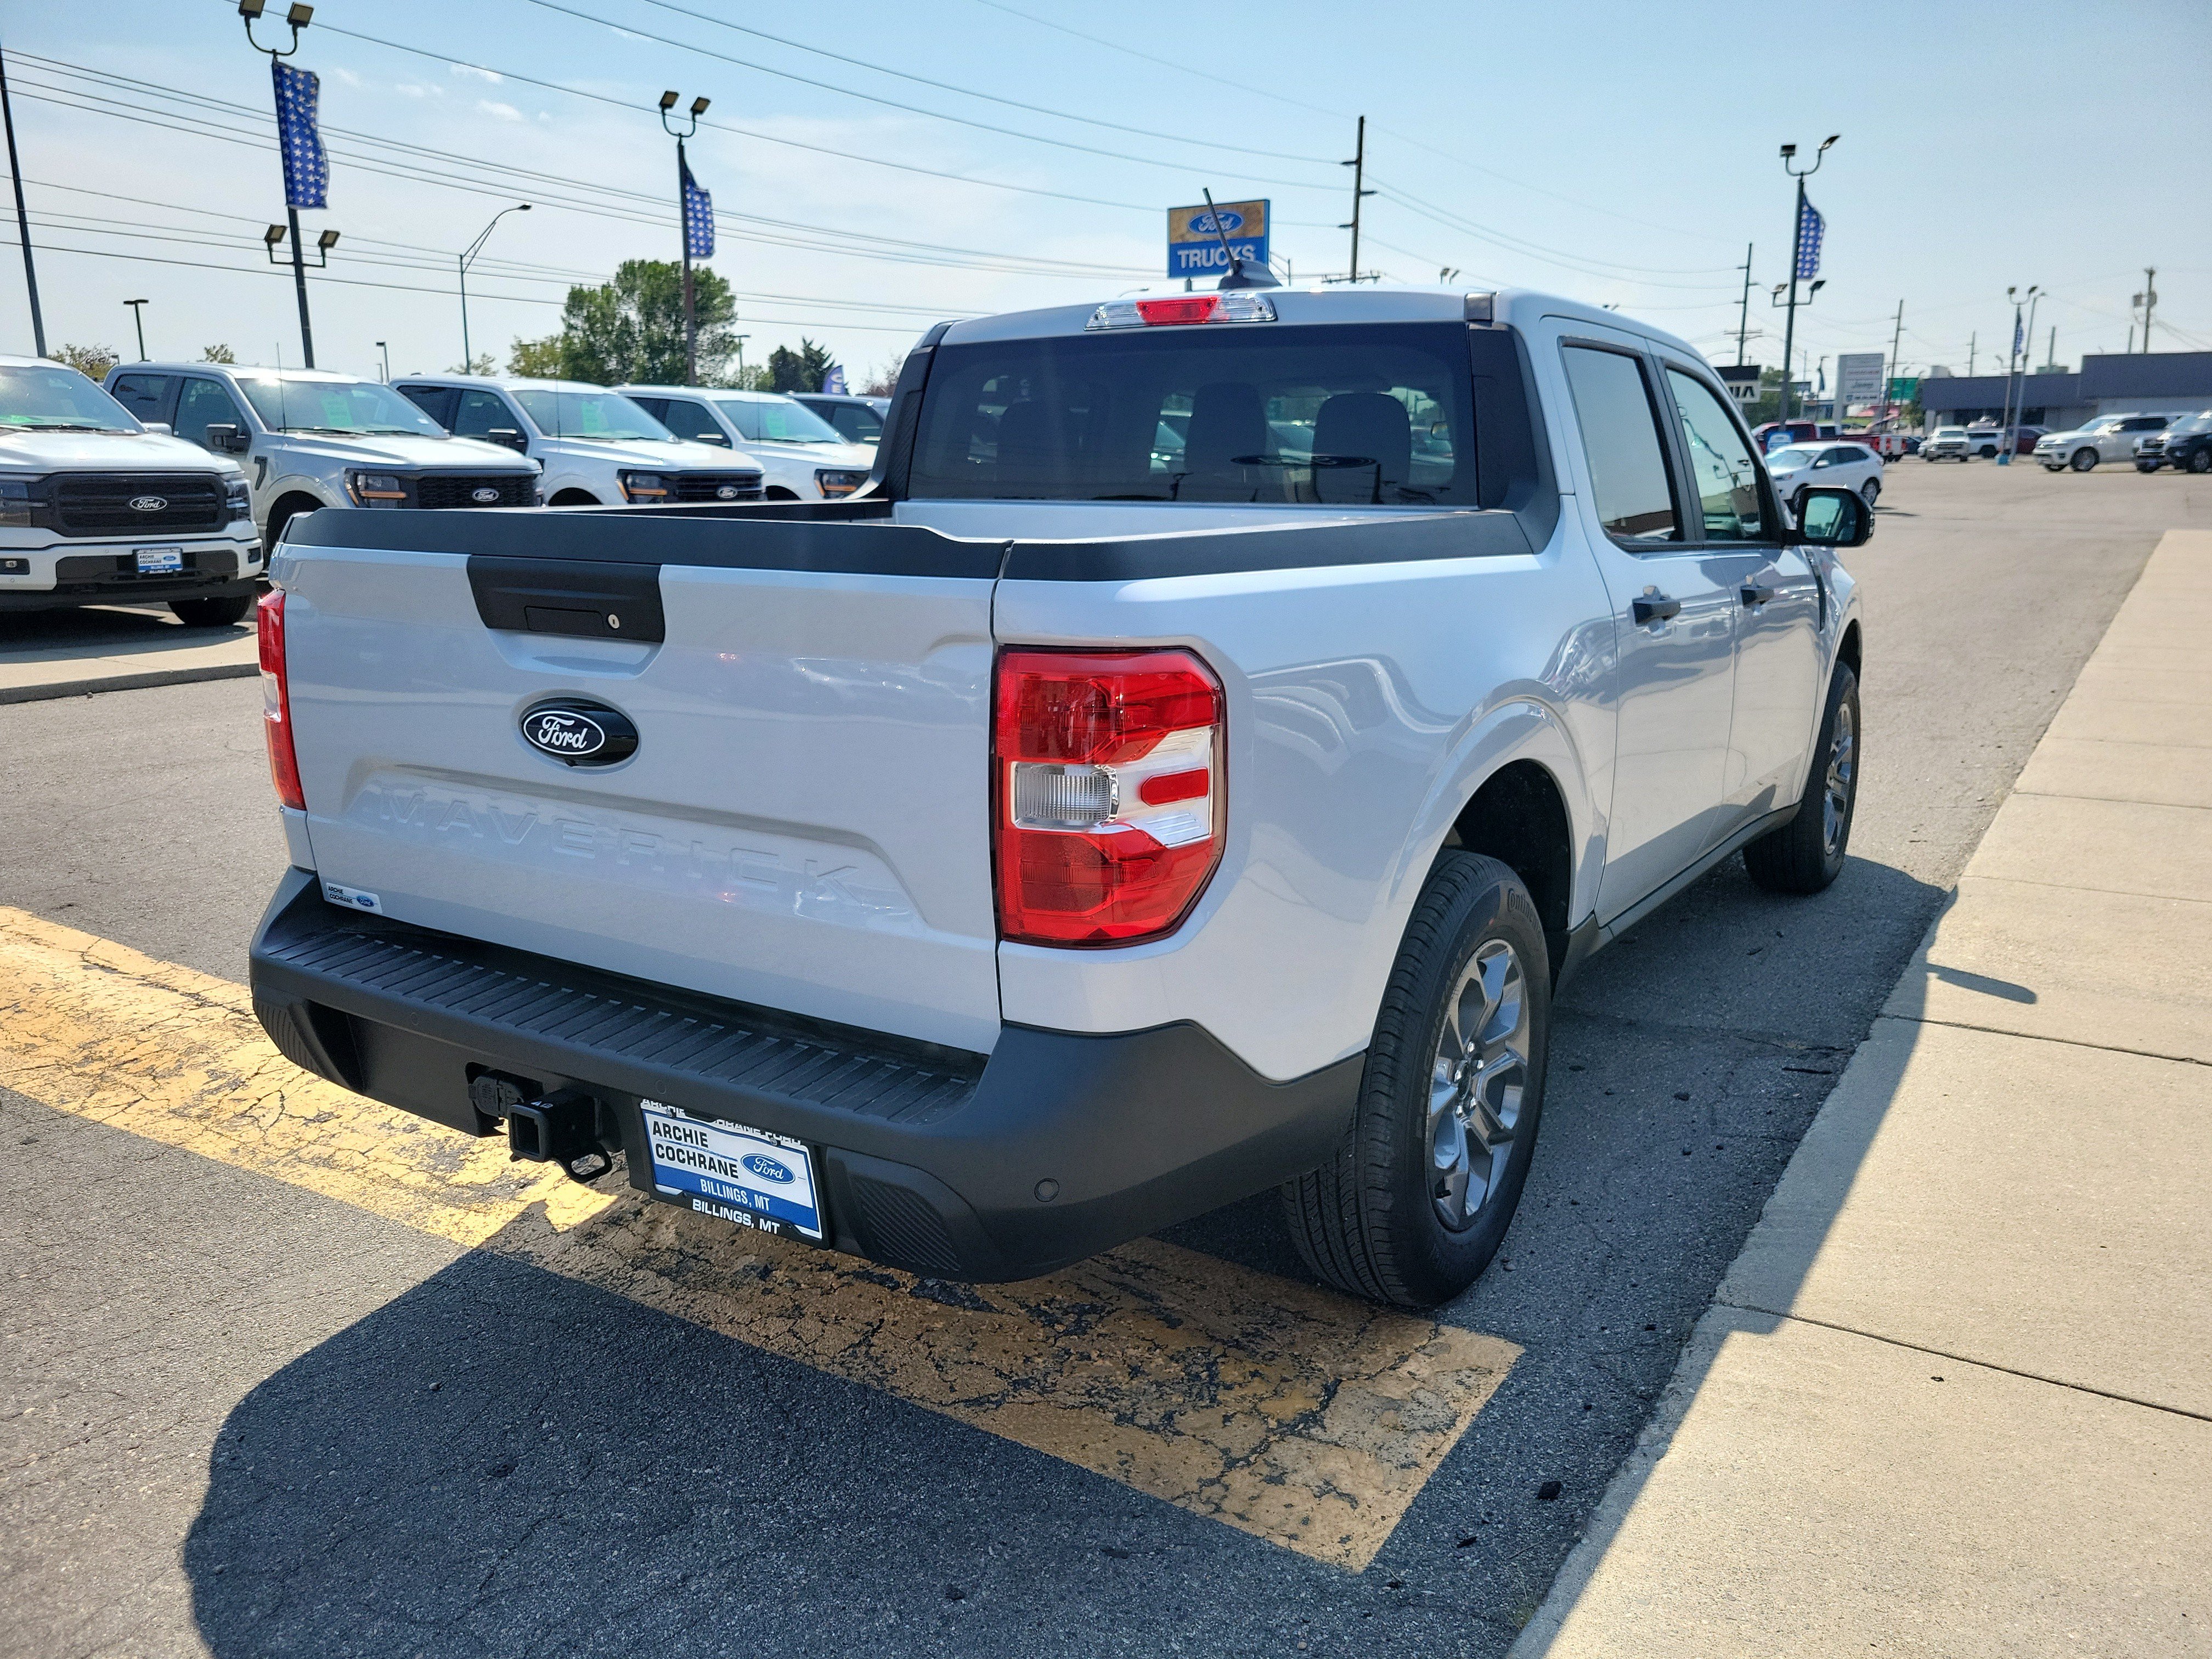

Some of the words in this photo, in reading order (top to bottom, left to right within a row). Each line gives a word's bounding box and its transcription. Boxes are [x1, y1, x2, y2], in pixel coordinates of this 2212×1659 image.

[137, 498, 161, 509] Ford
[538, 715, 589, 749] Ford
[380, 792, 864, 903] MAVERICK
[652, 1120, 709, 1149] ARCHIE
[655, 1143, 740, 1180] COCHRANE
[753, 1156, 785, 1180] Ford
[699, 1178, 752, 1208] BILLINGS,
[754, 1194, 770, 1211] MT
[692, 1198, 755, 1229] BILLINGS,
[759, 1217, 781, 1235] MT
